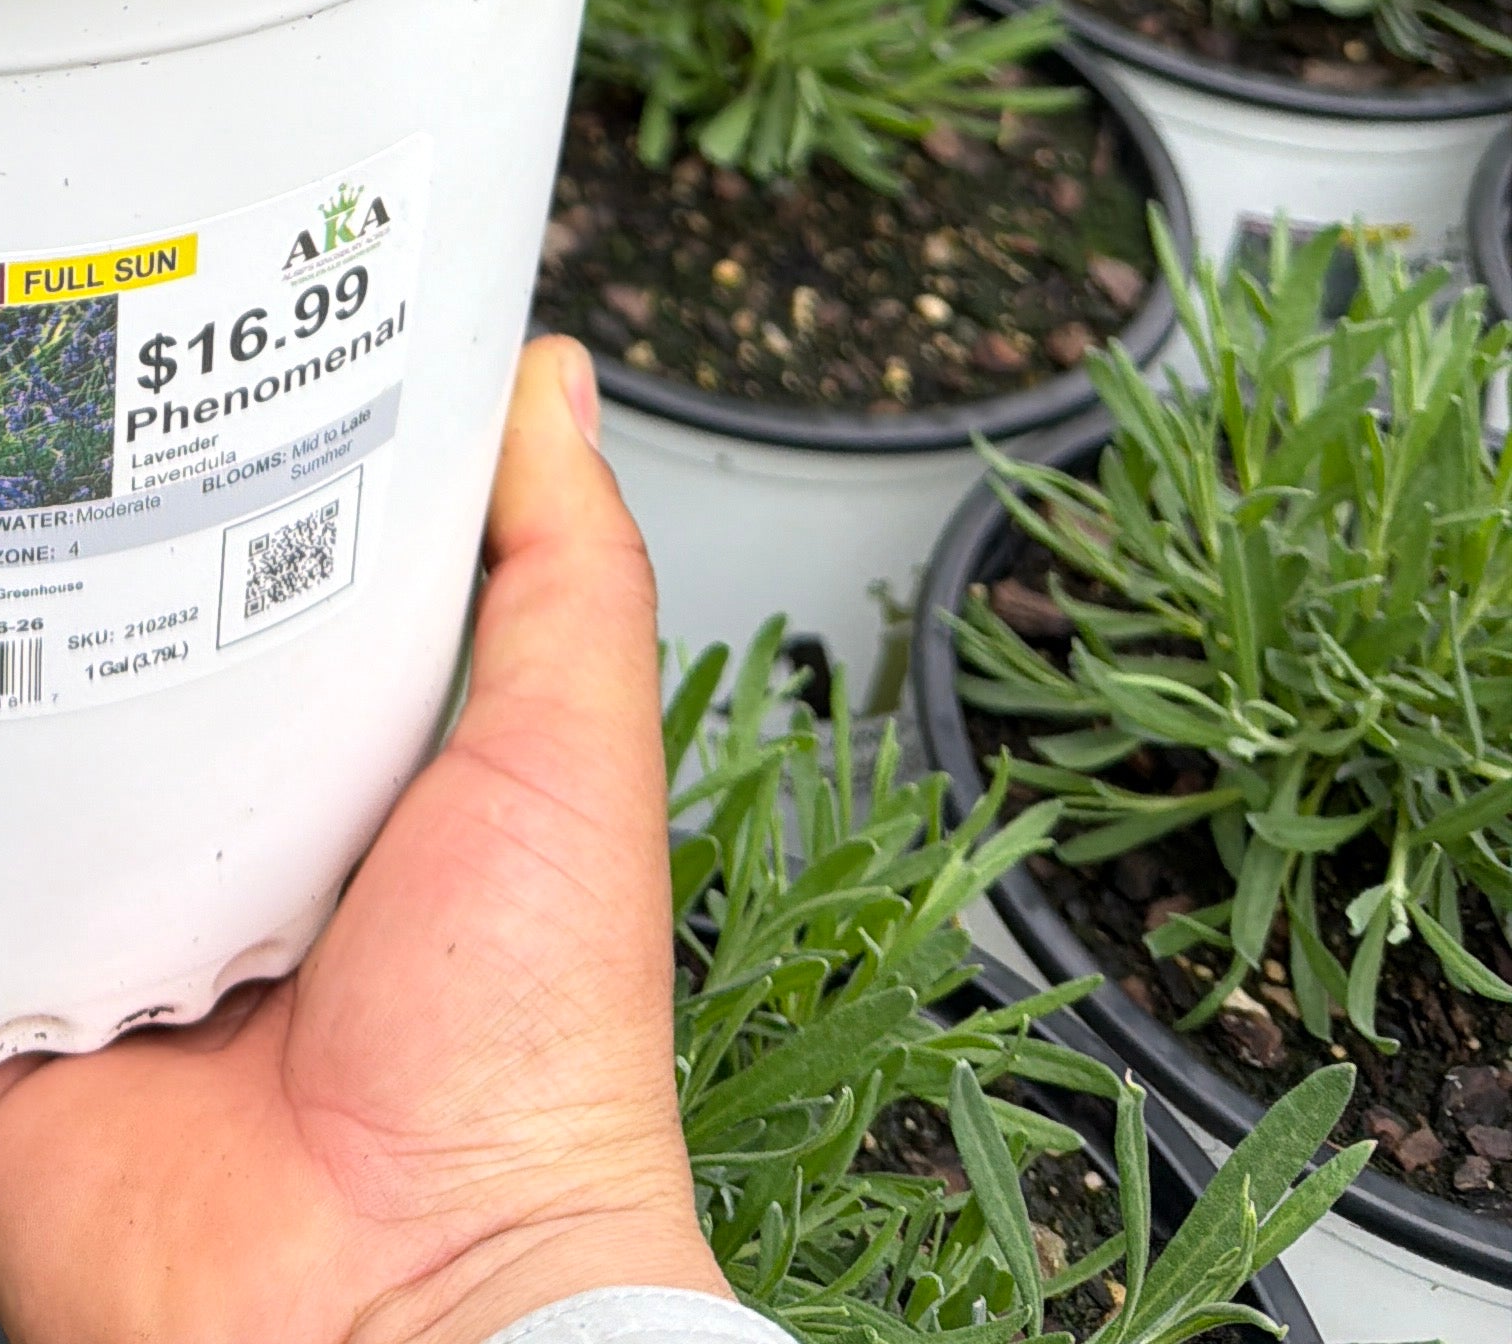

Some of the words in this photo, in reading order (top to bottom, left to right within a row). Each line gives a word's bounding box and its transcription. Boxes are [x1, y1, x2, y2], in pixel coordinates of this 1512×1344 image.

[281, 195, 391, 271] AKA
[24, 263, 104, 295] FULL
[114, 246, 177, 283] SUN
[137, 264, 369, 395] $16.99
[126, 299, 406, 443] Phenomenal
[131, 433, 220, 469] Lavender
[131, 450, 237, 492] Lavendula
[202, 451, 287, 494] BLOOMS:
[291, 434, 320, 461] Mid
[324, 429, 338, 444] to
[340, 407, 372, 436] Late
[290, 438, 354, 481] Summer
[76, 495, 162, 524] Moderate
[69, 541, 80, 557] 4
[68, 629, 115, 650] SKU:
[99, 656, 129, 677] Gal
